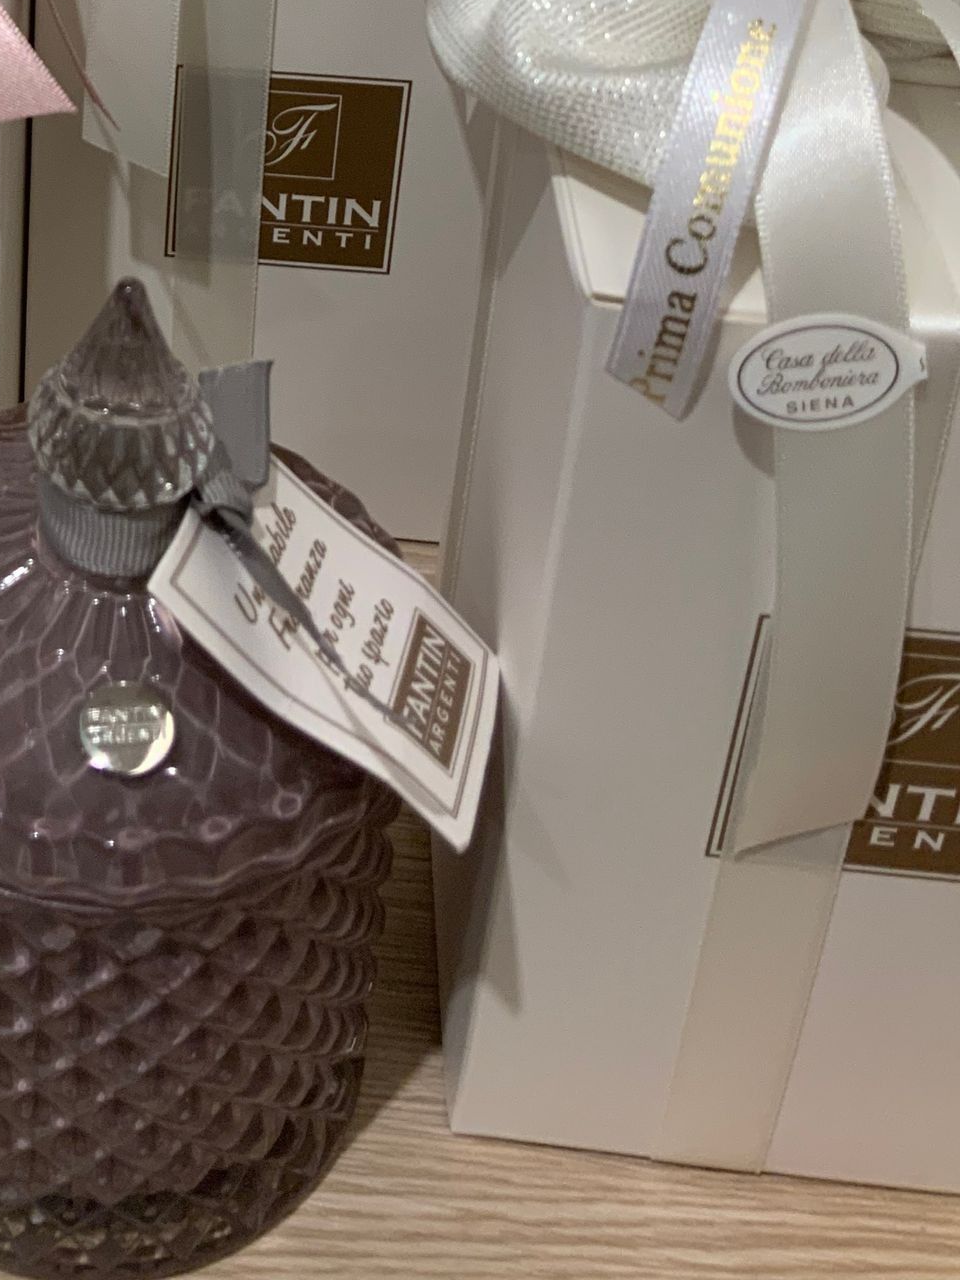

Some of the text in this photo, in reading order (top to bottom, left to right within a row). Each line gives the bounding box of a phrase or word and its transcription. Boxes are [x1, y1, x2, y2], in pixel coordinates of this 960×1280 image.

[628, 17, 778, 407] Prima Comunione
[757, 365, 880, 397] Bomboniera
[761, 348, 814, 371] Casa
[786, 395, 855, 415] SIENA
[334, 578, 356, 631] ogni
[360, 597, 395, 668] spazio
[403, 624, 447, 740] FANTIN
[430, 651, 462, 758] ARGENTI
